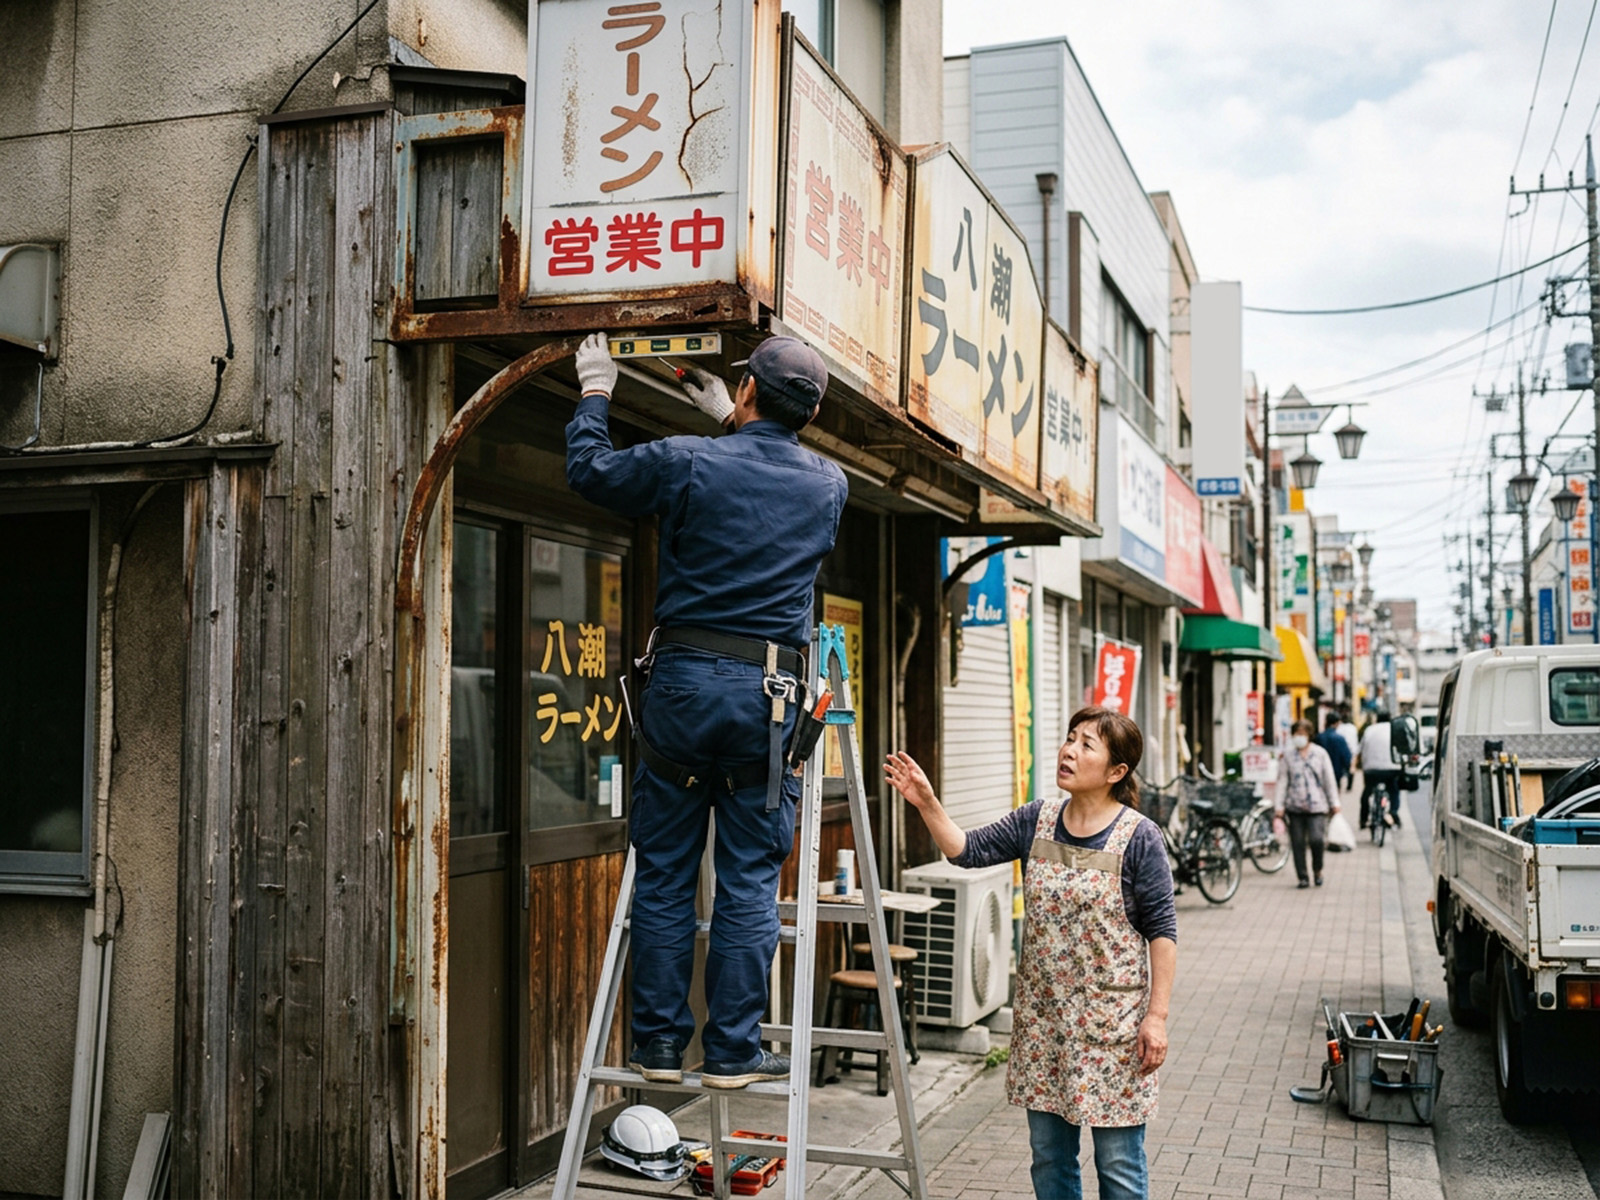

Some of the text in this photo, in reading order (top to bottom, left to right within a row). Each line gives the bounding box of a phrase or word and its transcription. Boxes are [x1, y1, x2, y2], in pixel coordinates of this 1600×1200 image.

[601, 2, 665, 193] ラーメン
[544, 208, 725, 277] 営業中
[804, 160, 892, 306] 営業中
[953, 207, 1012, 326] 八潮
[918, 267, 1034, 438] ラーメン
[540, 620, 608, 678] 八潮
[536, 692, 622, 744] ラーメン
